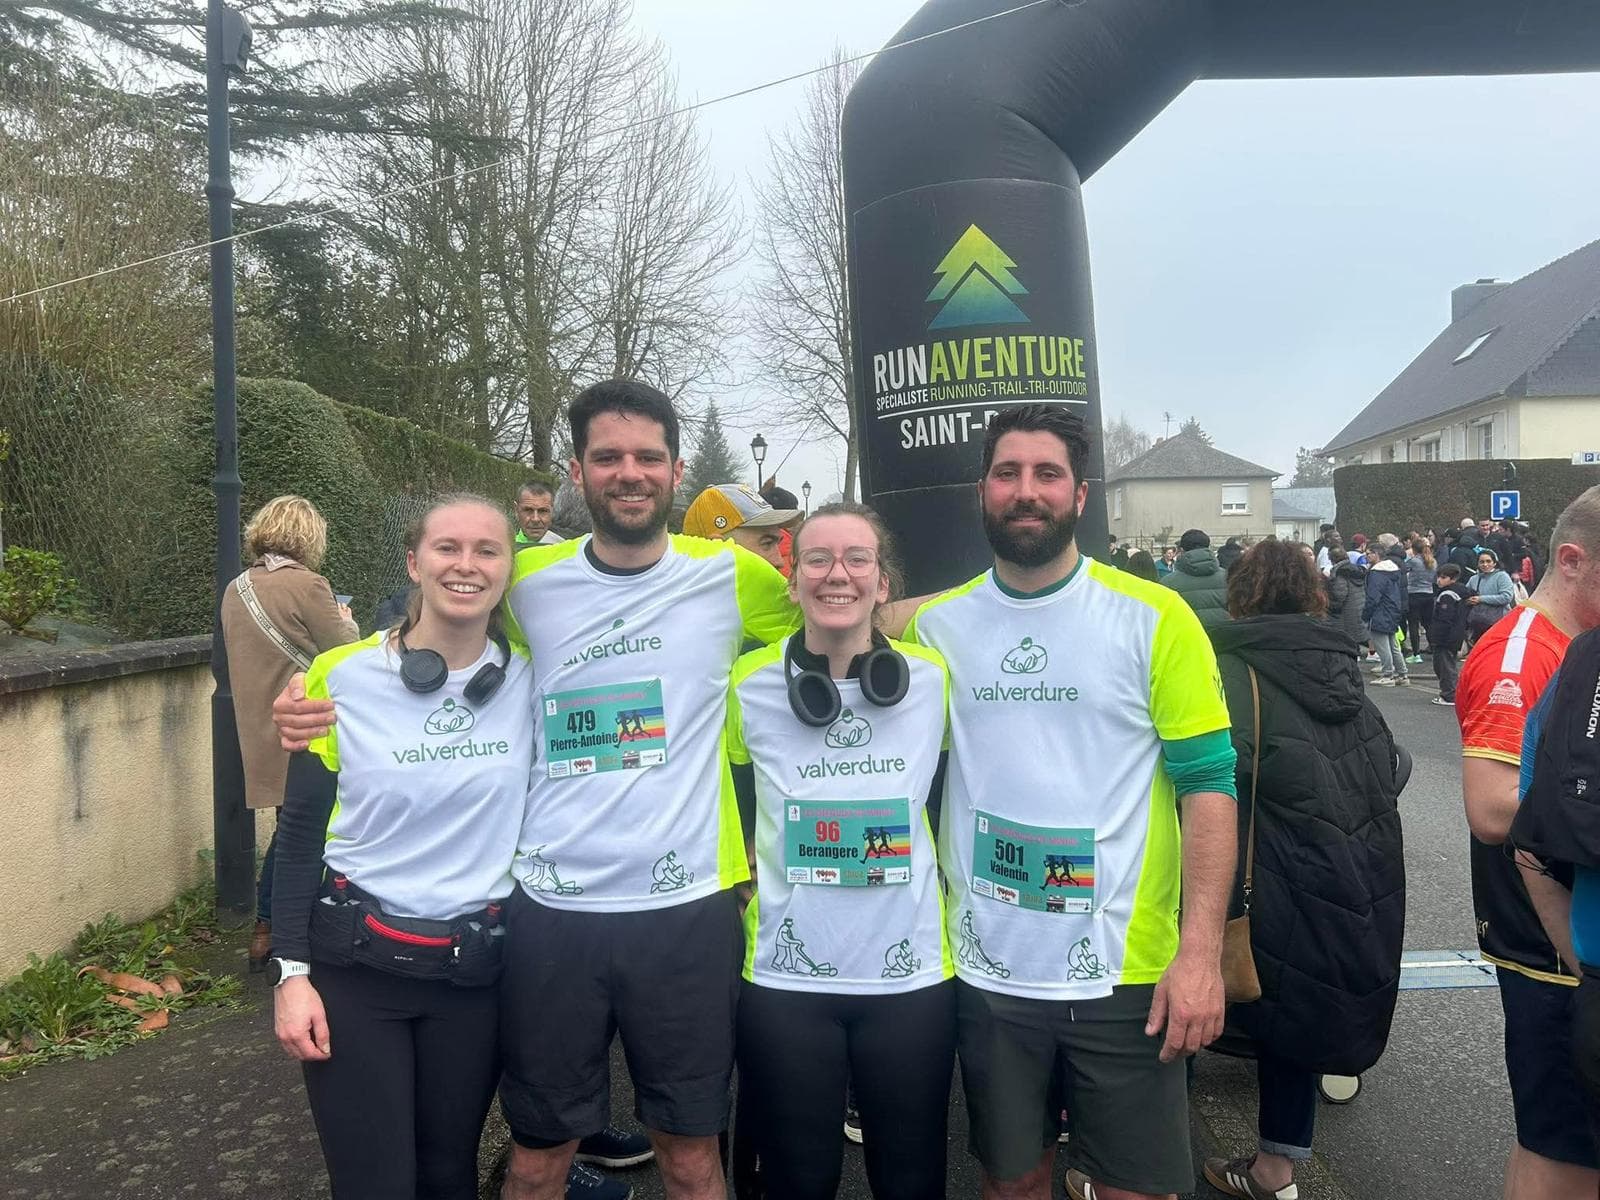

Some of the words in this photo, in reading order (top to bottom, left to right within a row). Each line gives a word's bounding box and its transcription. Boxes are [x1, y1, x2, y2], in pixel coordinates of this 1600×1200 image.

[873, 335, 1086, 394] RUNAVENTURE
[876, 388, 929, 411] SPÉCIALISTE
[1499, 496, 1512, 514] P
[972, 680, 1079, 702] valverdure
[567, 709, 596, 734] 479
[392, 738, 509, 764] valverdure
[550, 731, 619, 753] Pierre-Antoine
[796, 753, 906, 779] valverdure
[815, 820, 840, 843] 96
[798, 843, 859, 859] Berangere
[995, 839, 1024, 867] 501
[990, 859, 1029, 882] Valentin
